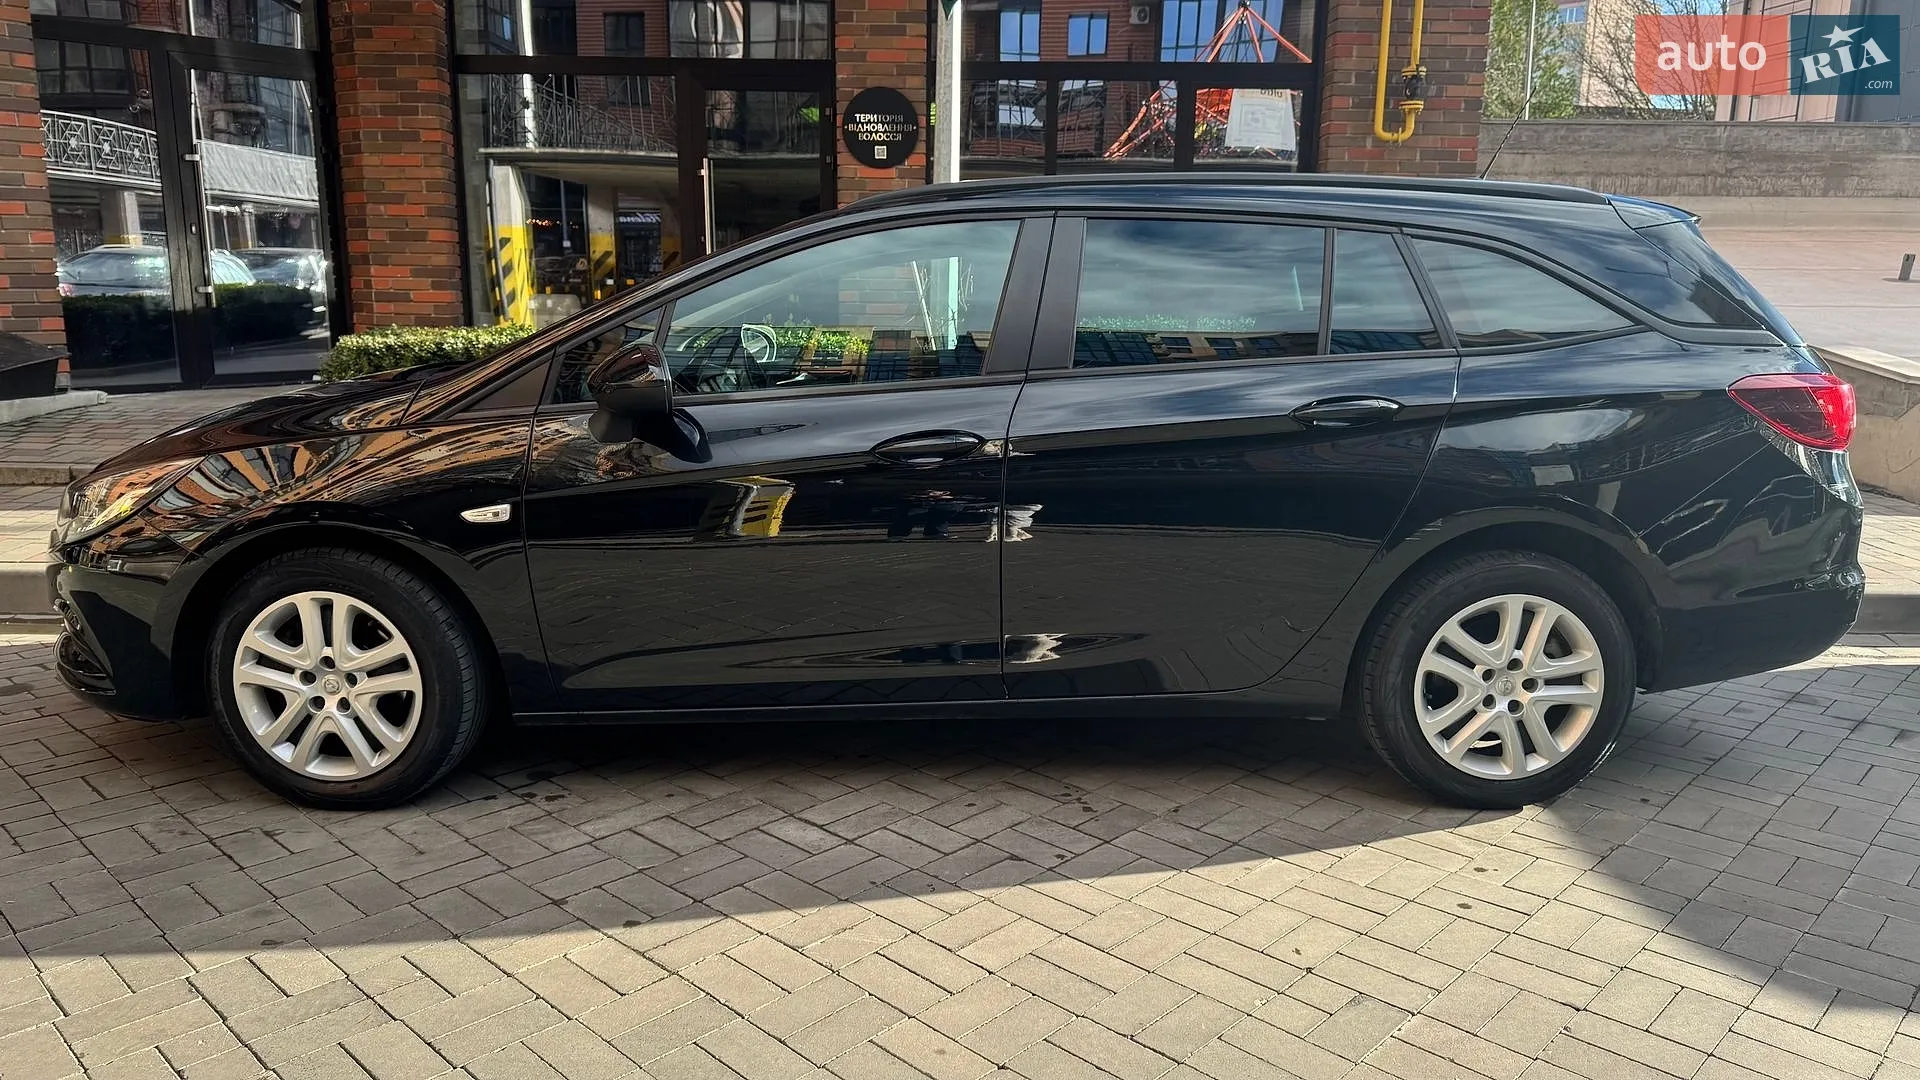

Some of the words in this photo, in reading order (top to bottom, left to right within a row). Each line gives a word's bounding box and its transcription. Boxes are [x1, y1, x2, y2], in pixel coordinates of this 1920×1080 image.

[854, 114, 904, 122] ТЕРИТОРІЯ
[848, 124, 912, 132] ВІДНОВЛЕННЯ
[858, 133, 902, 141] ВОЛОССЯ
